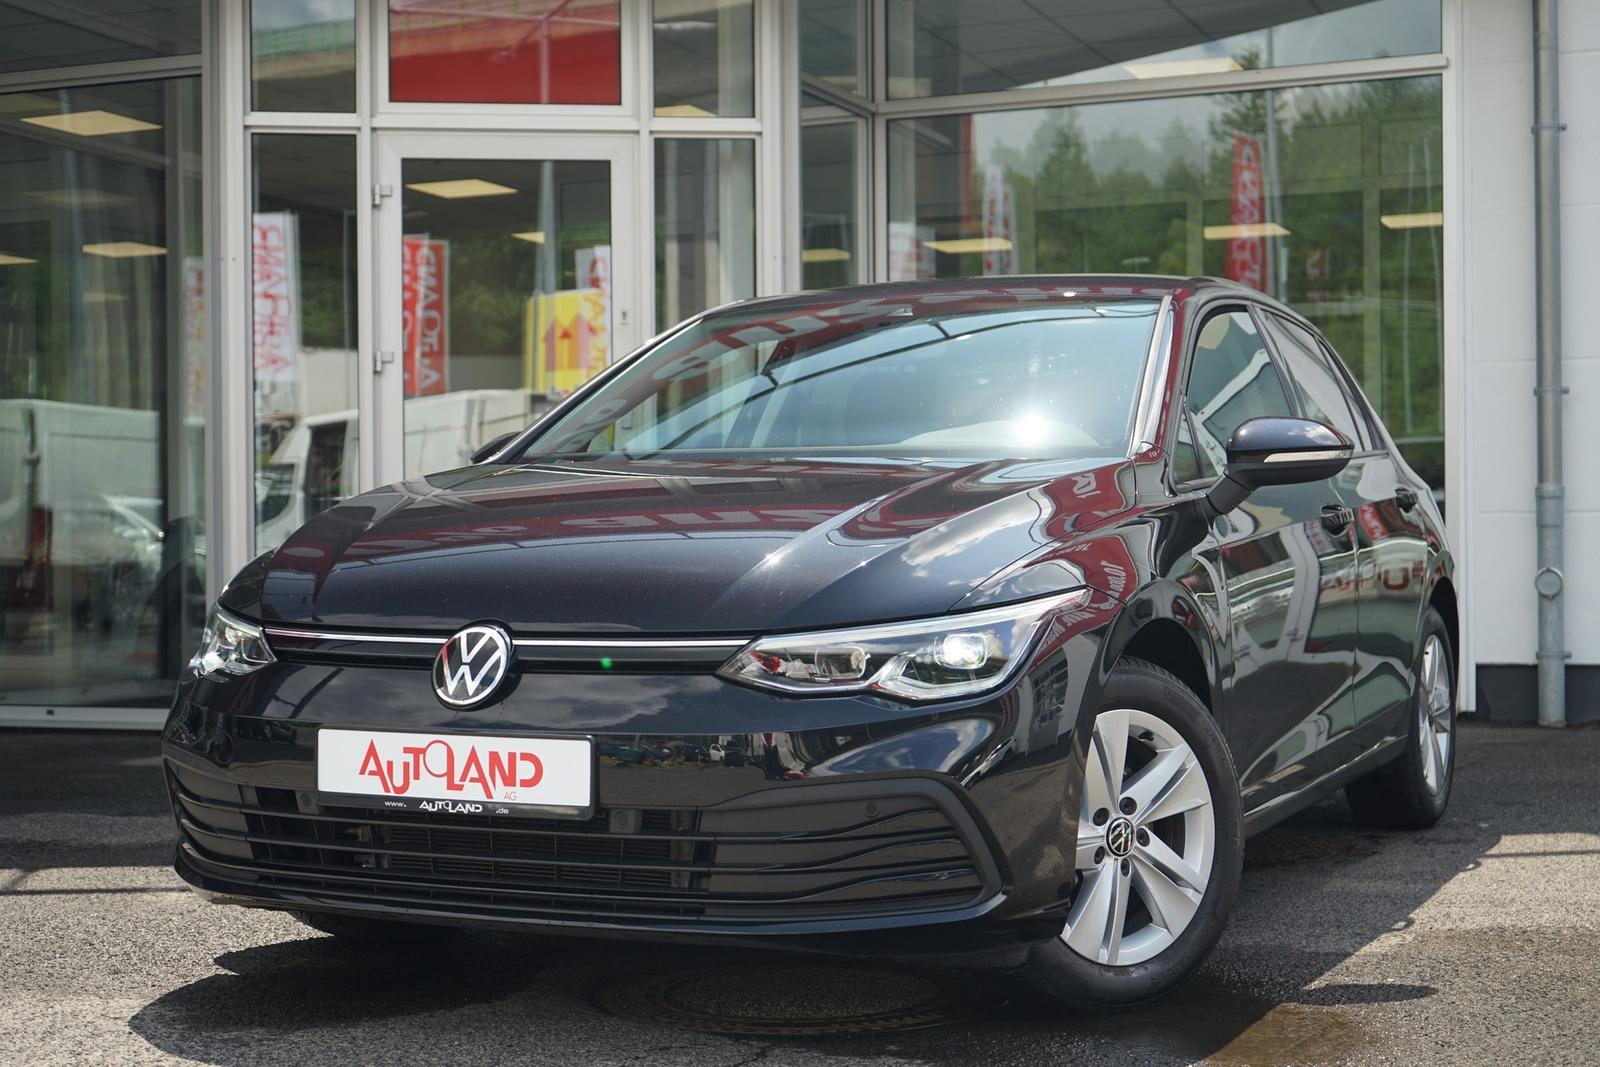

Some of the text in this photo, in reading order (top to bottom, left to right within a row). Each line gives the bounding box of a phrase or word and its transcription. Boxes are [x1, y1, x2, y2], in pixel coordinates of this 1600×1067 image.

[358, 739, 544, 800] AUTOLAND
[504, 791, 517, 801] AG
[384, 800, 509, 815] www. AUTOLAND .de
